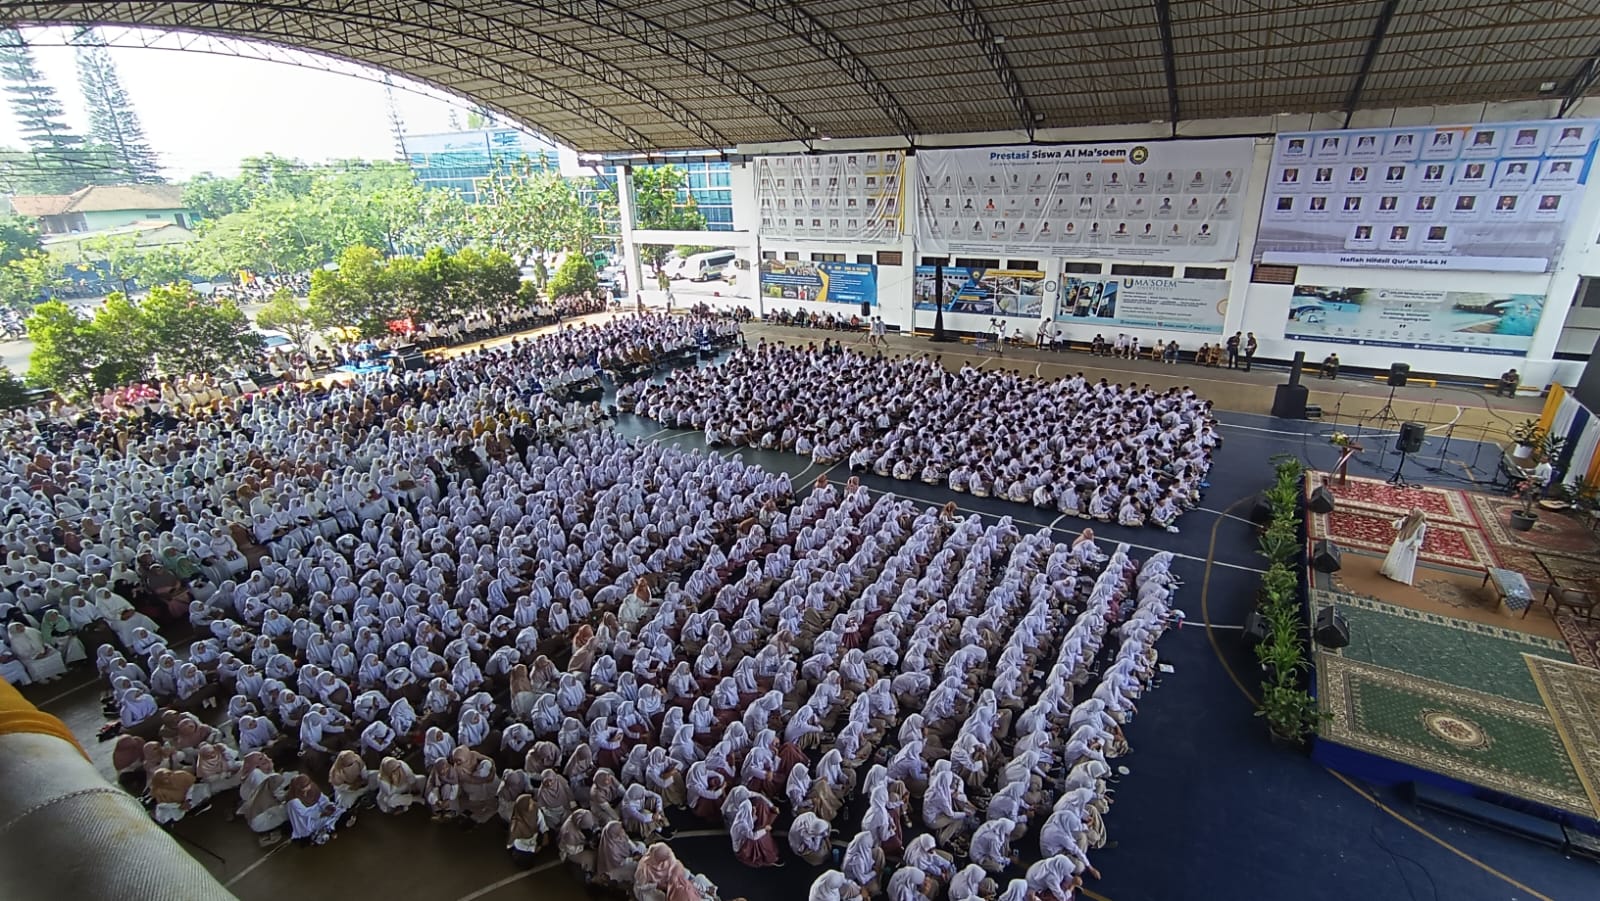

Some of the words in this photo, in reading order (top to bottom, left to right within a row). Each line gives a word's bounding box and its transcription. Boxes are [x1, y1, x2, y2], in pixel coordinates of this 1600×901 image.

[990, 151, 1030, 161] Prestasi
[1031, 149, 1061, 159] Siswa
[1064, 149, 1075, 158] Al
[1078, 147, 1127, 157] Ma'soem
[1135, 279, 1177, 288] MA'SOEM
